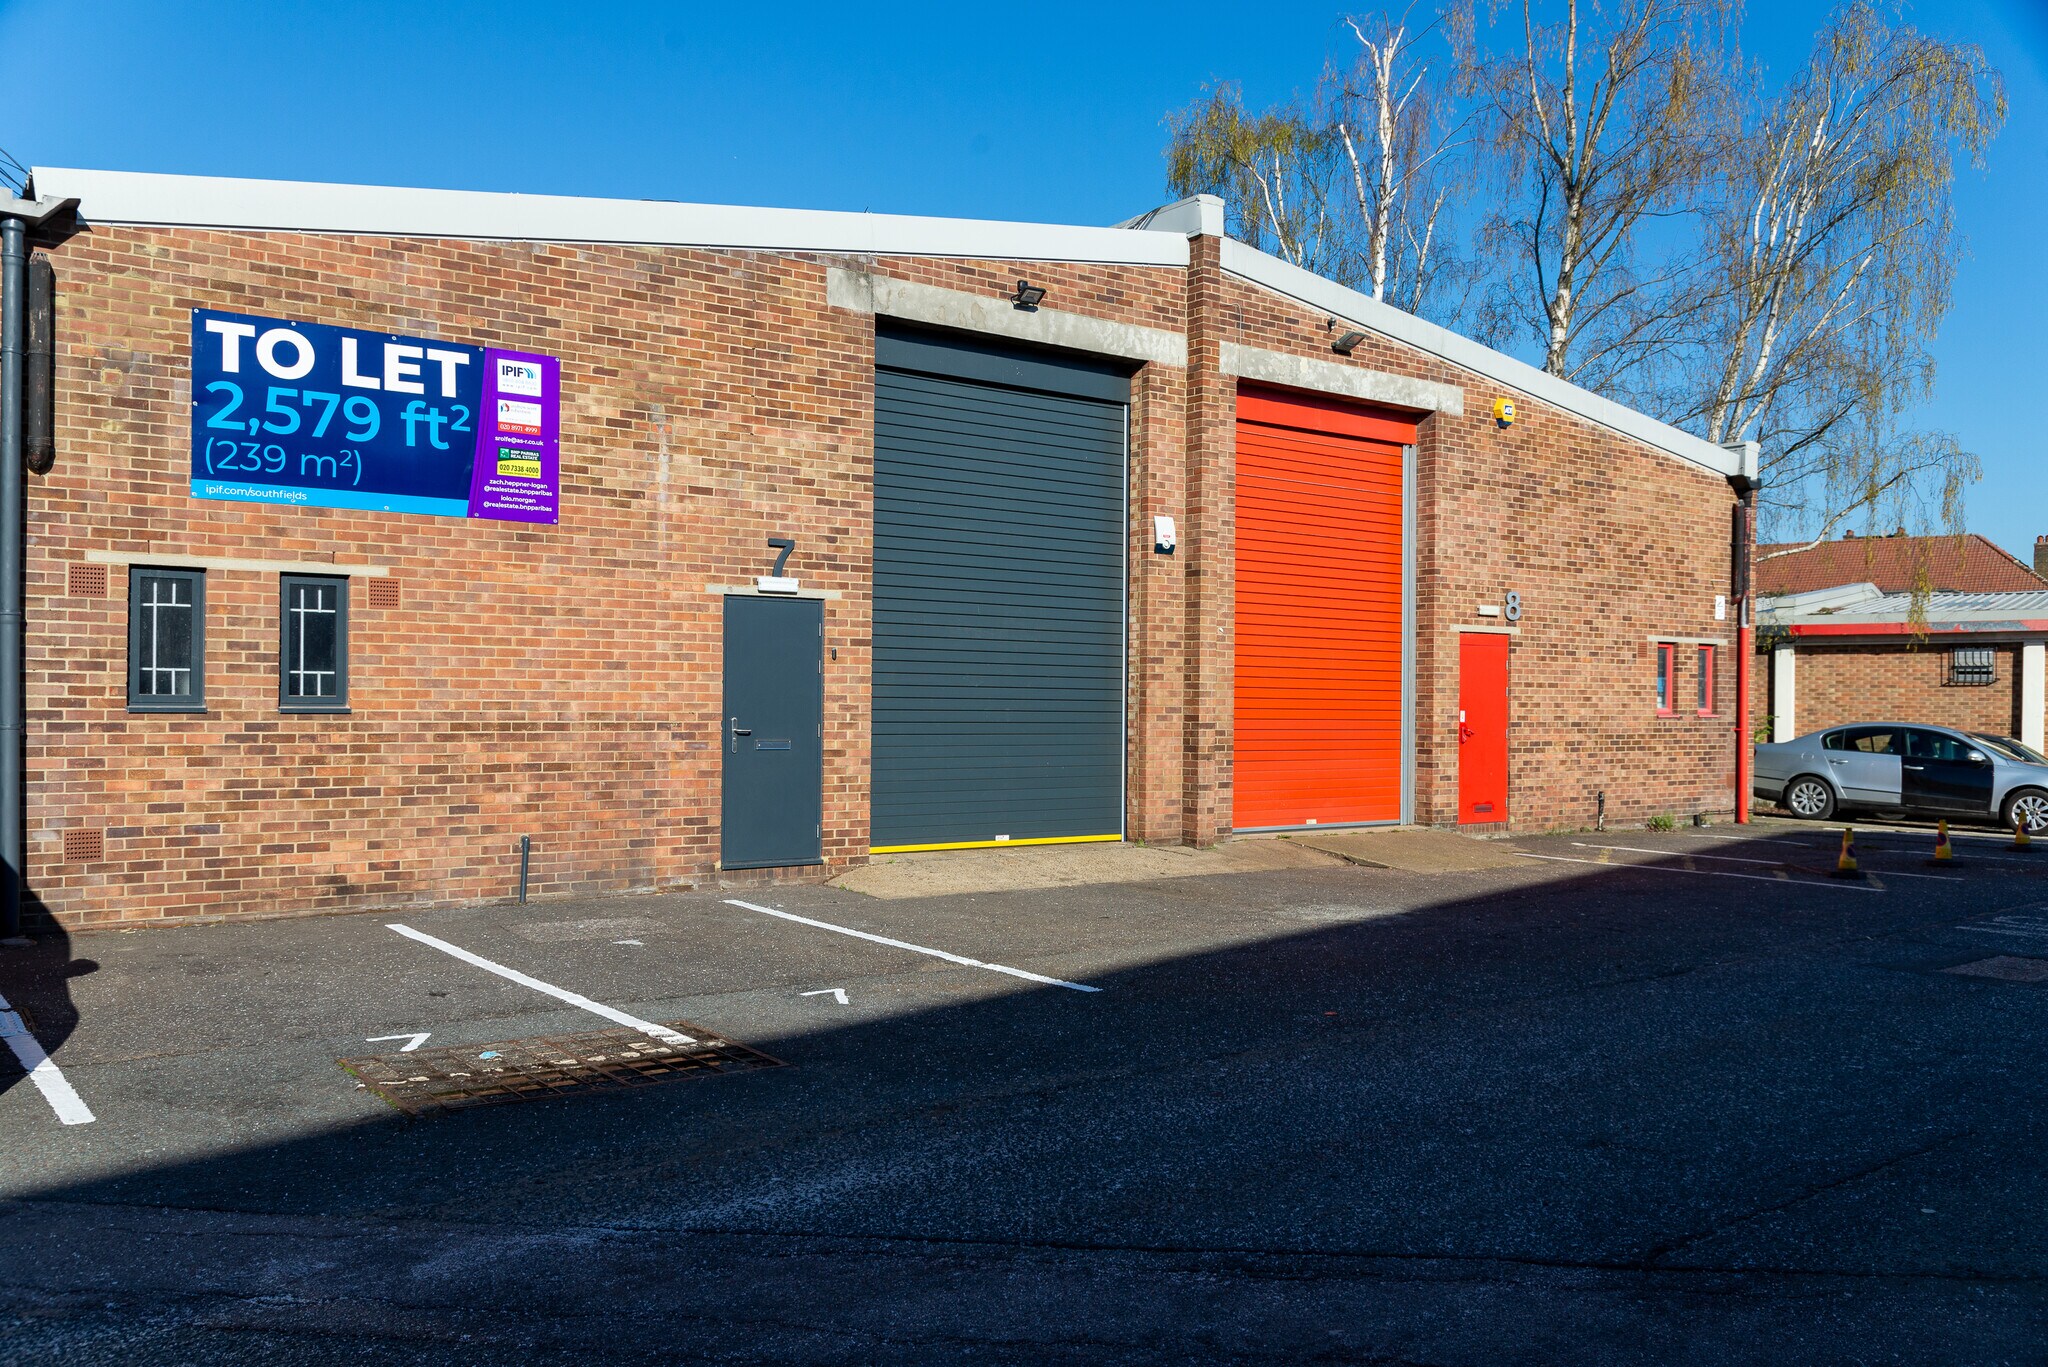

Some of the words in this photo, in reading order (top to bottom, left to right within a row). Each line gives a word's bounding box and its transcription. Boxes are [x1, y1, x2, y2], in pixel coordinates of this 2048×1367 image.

[205, 319, 315, 380] TO
[342, 337, 470, 398] LET
[502, 365, 524, 378] IPIF
[205, 381, 381, 442] 2,579
[205, 437, 286, 475] (239
[205, 484, 307, 501] ipif.com/southfields
[484, 485, 552, 495] @realestate.bnpparibas
[490, 479, 547, 489] zach.heppner-logan
[484, 501, 552, 511] @realestate.bnpparibas
[768, 538, 795, 577] 7
[1504, 591, 1521, 621] 8
